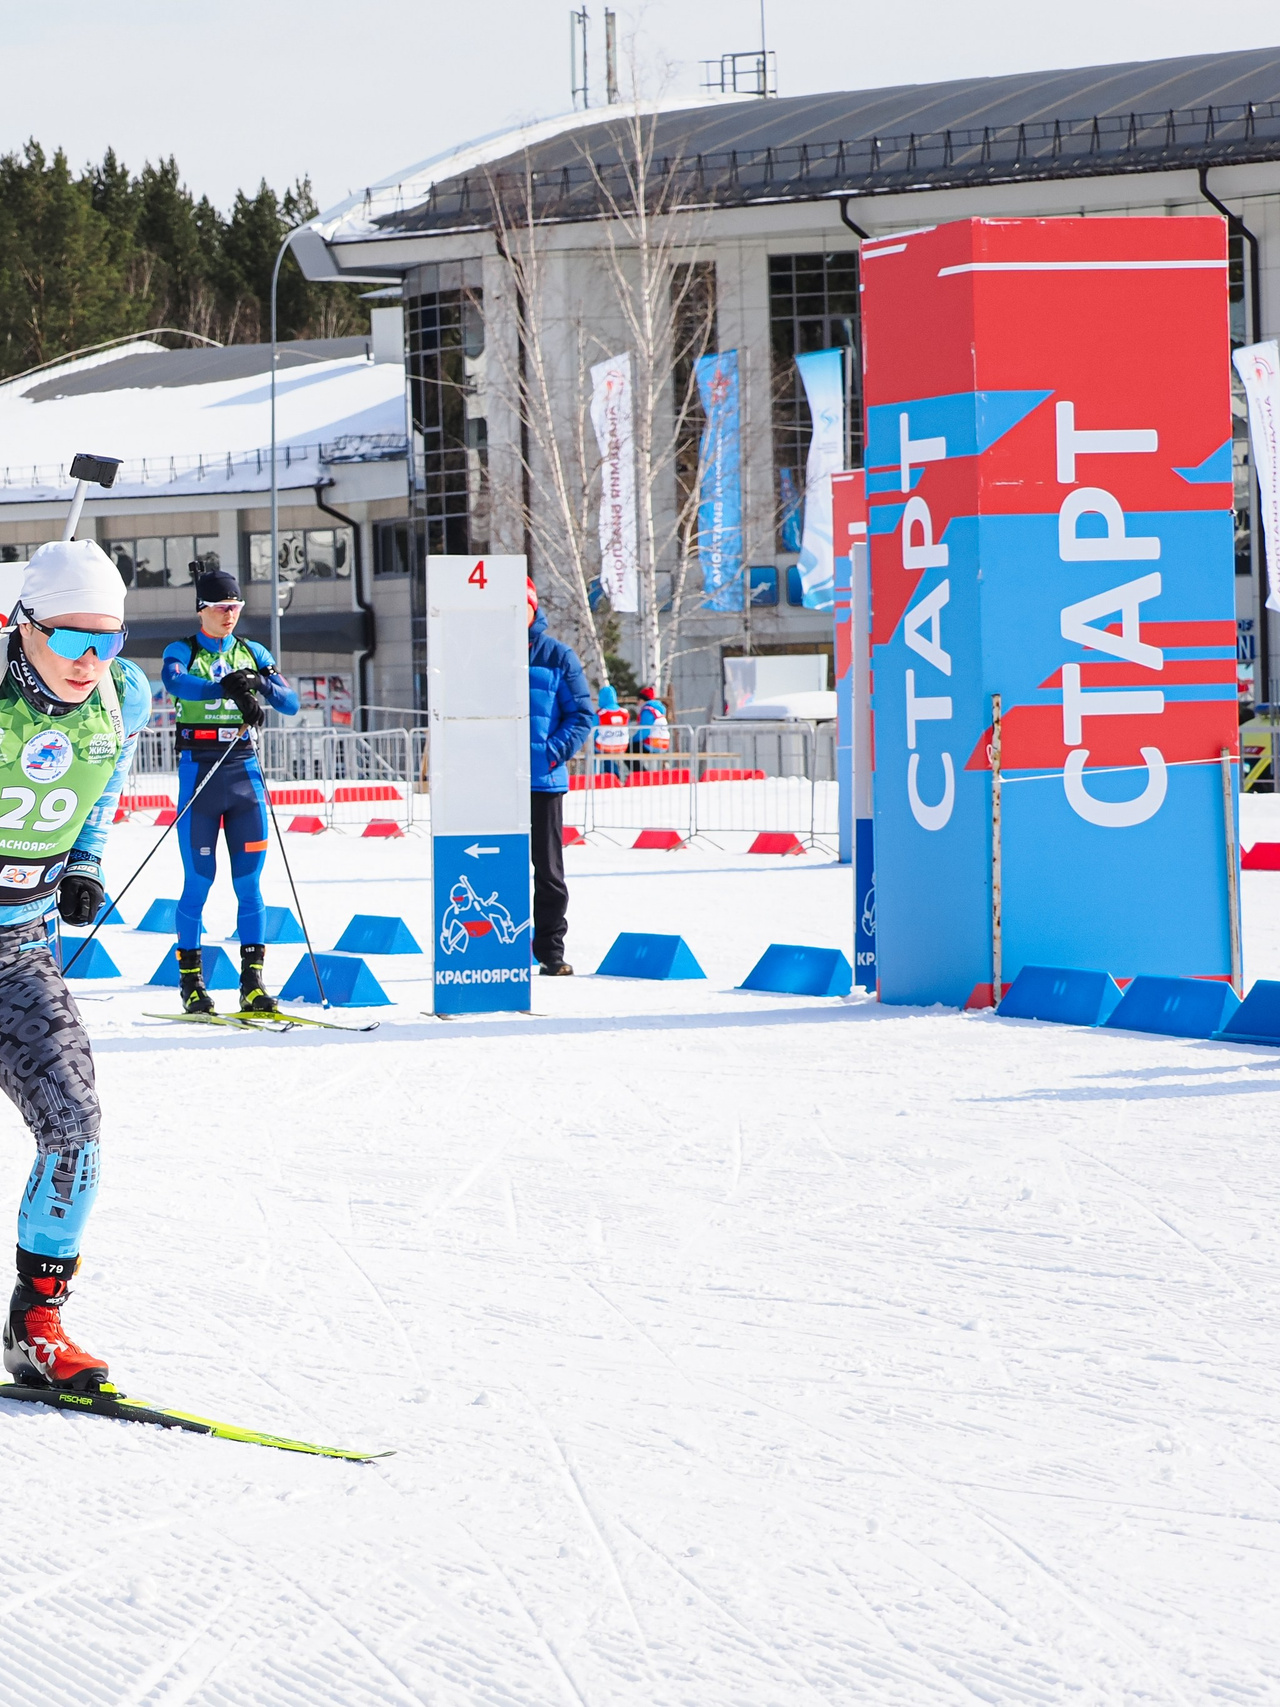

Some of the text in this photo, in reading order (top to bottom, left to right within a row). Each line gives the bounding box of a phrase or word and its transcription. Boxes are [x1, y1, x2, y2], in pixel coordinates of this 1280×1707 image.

[468, 561, 487, 589] 4
[900, 412, 954, 831] СТАРТ
[1056, 400, 1168, 828] СТАРТ
[435, 967, 529, 986] КРАСНОЯРСК
[40, 1262, 64, 1275] 179
[58, 1394, 93, 1406] FISCHER
